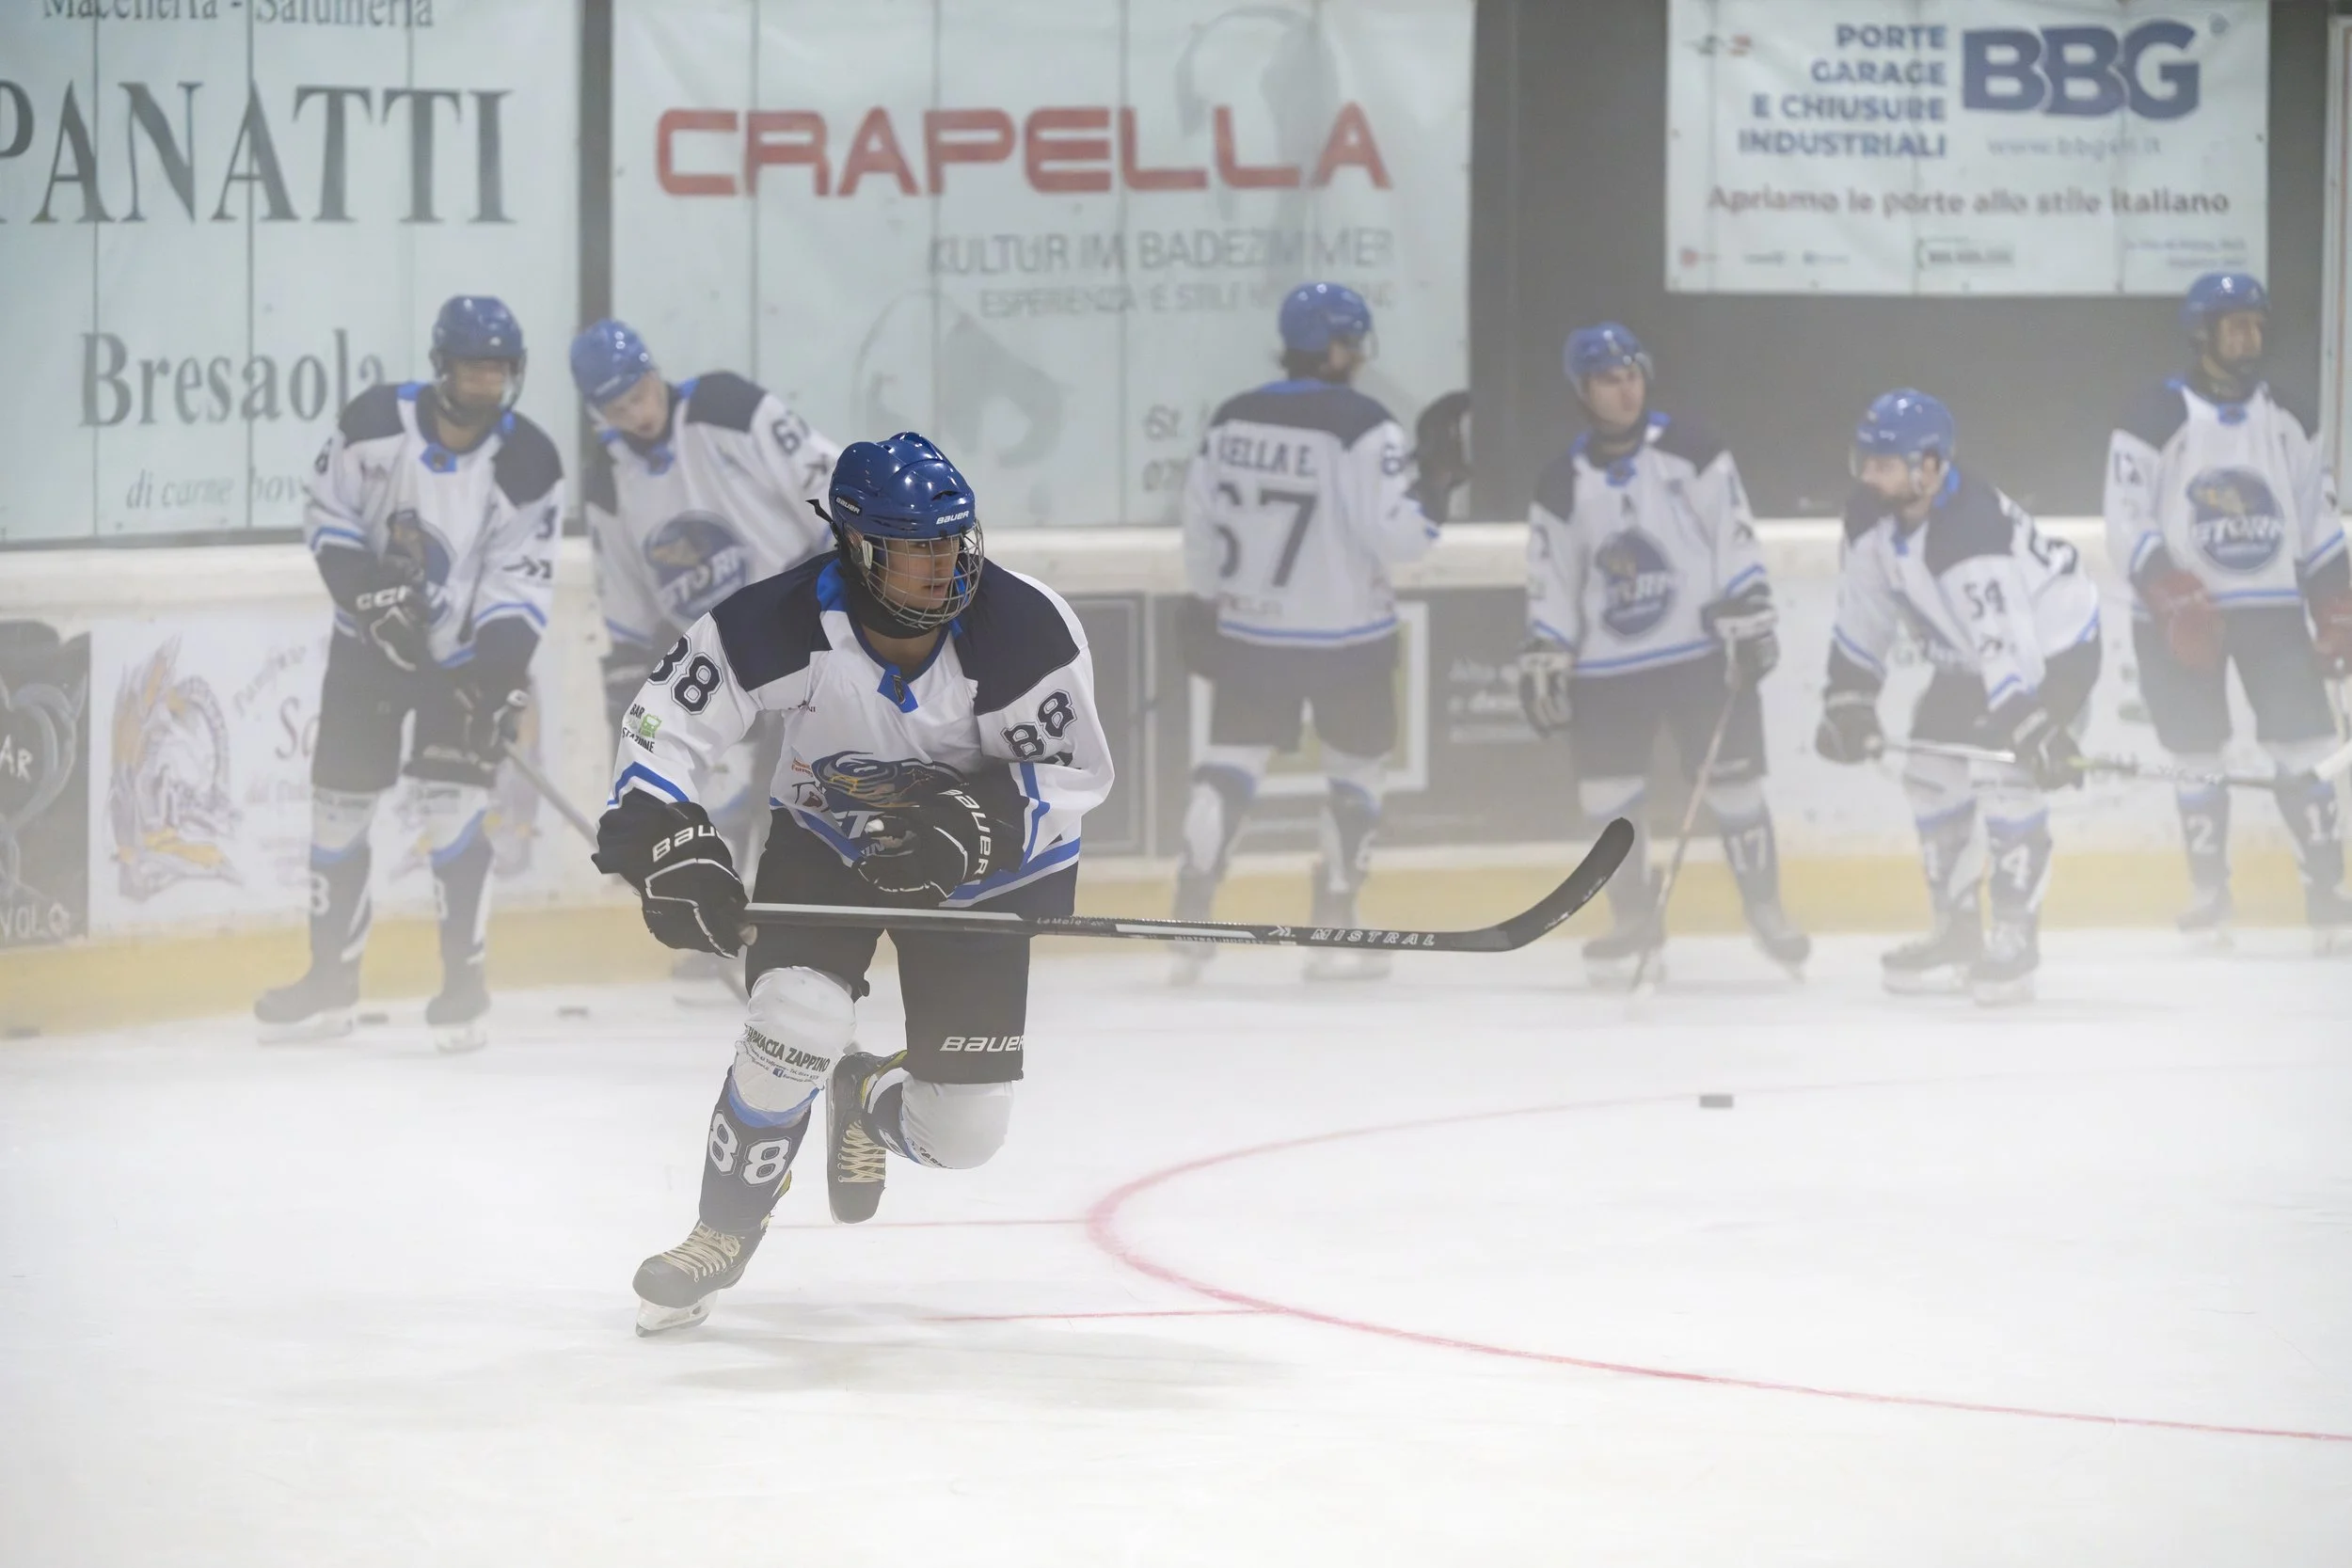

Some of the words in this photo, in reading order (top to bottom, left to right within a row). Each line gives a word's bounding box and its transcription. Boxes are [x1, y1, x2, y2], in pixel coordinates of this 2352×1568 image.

[1836, 24, 1947, 50] PORTE
[1811, 59, 1947, 86] GARAGE
[1963, 19, 2200, 121] BBG
[1752, 93, 1771, 119] E
[1781, 95, 1947, 121] CHIUSURE
[656, 102, 1393, 196] CRAPELLA
[1737, 128, 1947, 158] INDUSTRIALI
[835, 496, 861, 515] BAUER
[936, 510, 970, 525] BAUER
[630, 704, 645, 720] BAR
[999, 689, 1077, 762] 88
[652, 824, 721, 863] BAU
[936, 788, 992, 876] BAUER
[1311, 927, 1437, 947] MISTRAL
[785, 1047, 831, 1073] ZAPPINO
[707, 1110, 793, 1187] 88
